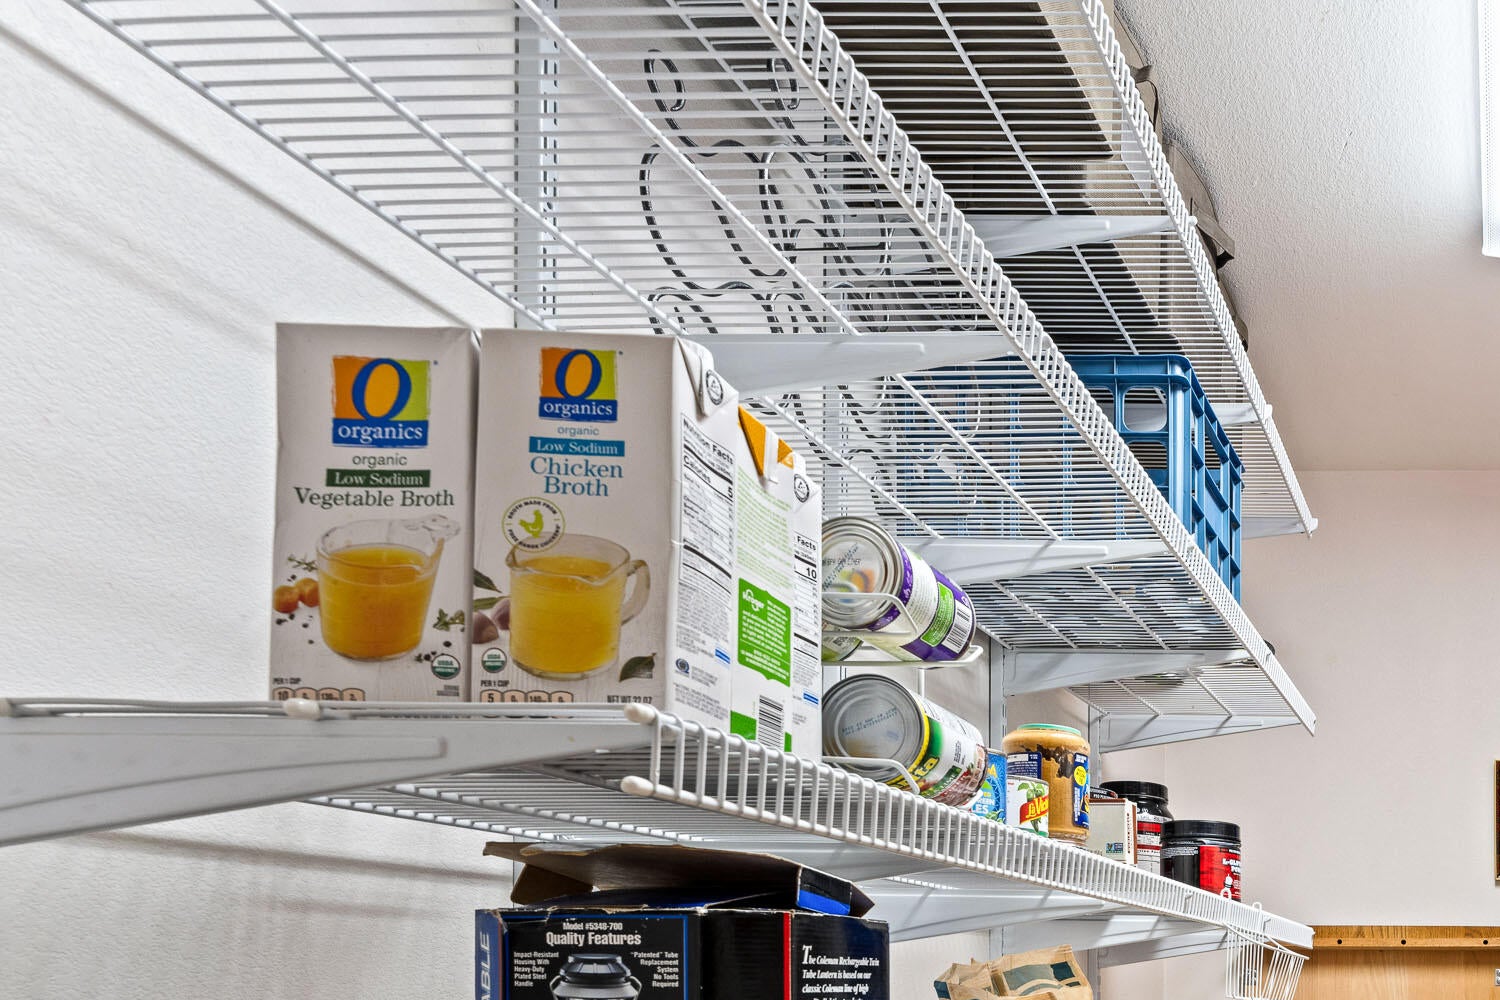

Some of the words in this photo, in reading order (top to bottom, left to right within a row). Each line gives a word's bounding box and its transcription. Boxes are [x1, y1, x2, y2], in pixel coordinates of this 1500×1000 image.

[543, 402, 613, 417] organics
[338, 424, 423, 444] organics
[557, 425, 599, 437] organic
[537, 440, 564, 451] Low
[569, 442, 618, 455] Sodium
[712, 445, 733, 465] Facts
[352, 453, 408, 468] organic
[530, 456, 624, 478] Chicken
[335, 472, 366, 485] Low
[370, 473, 423, 486] Sodium
[544, 475, 609, 497] Broth
[294, 487, 394, 510] Vegetable
[400, 489, 454, 506] Broth
[797, 536, 816, 551] Facts
[806, 567, 817, 579] 10
[563, 922, 583, 931] Model
[546, 932, 585, 946] Quality
[588, 932, 642, 945] Features
